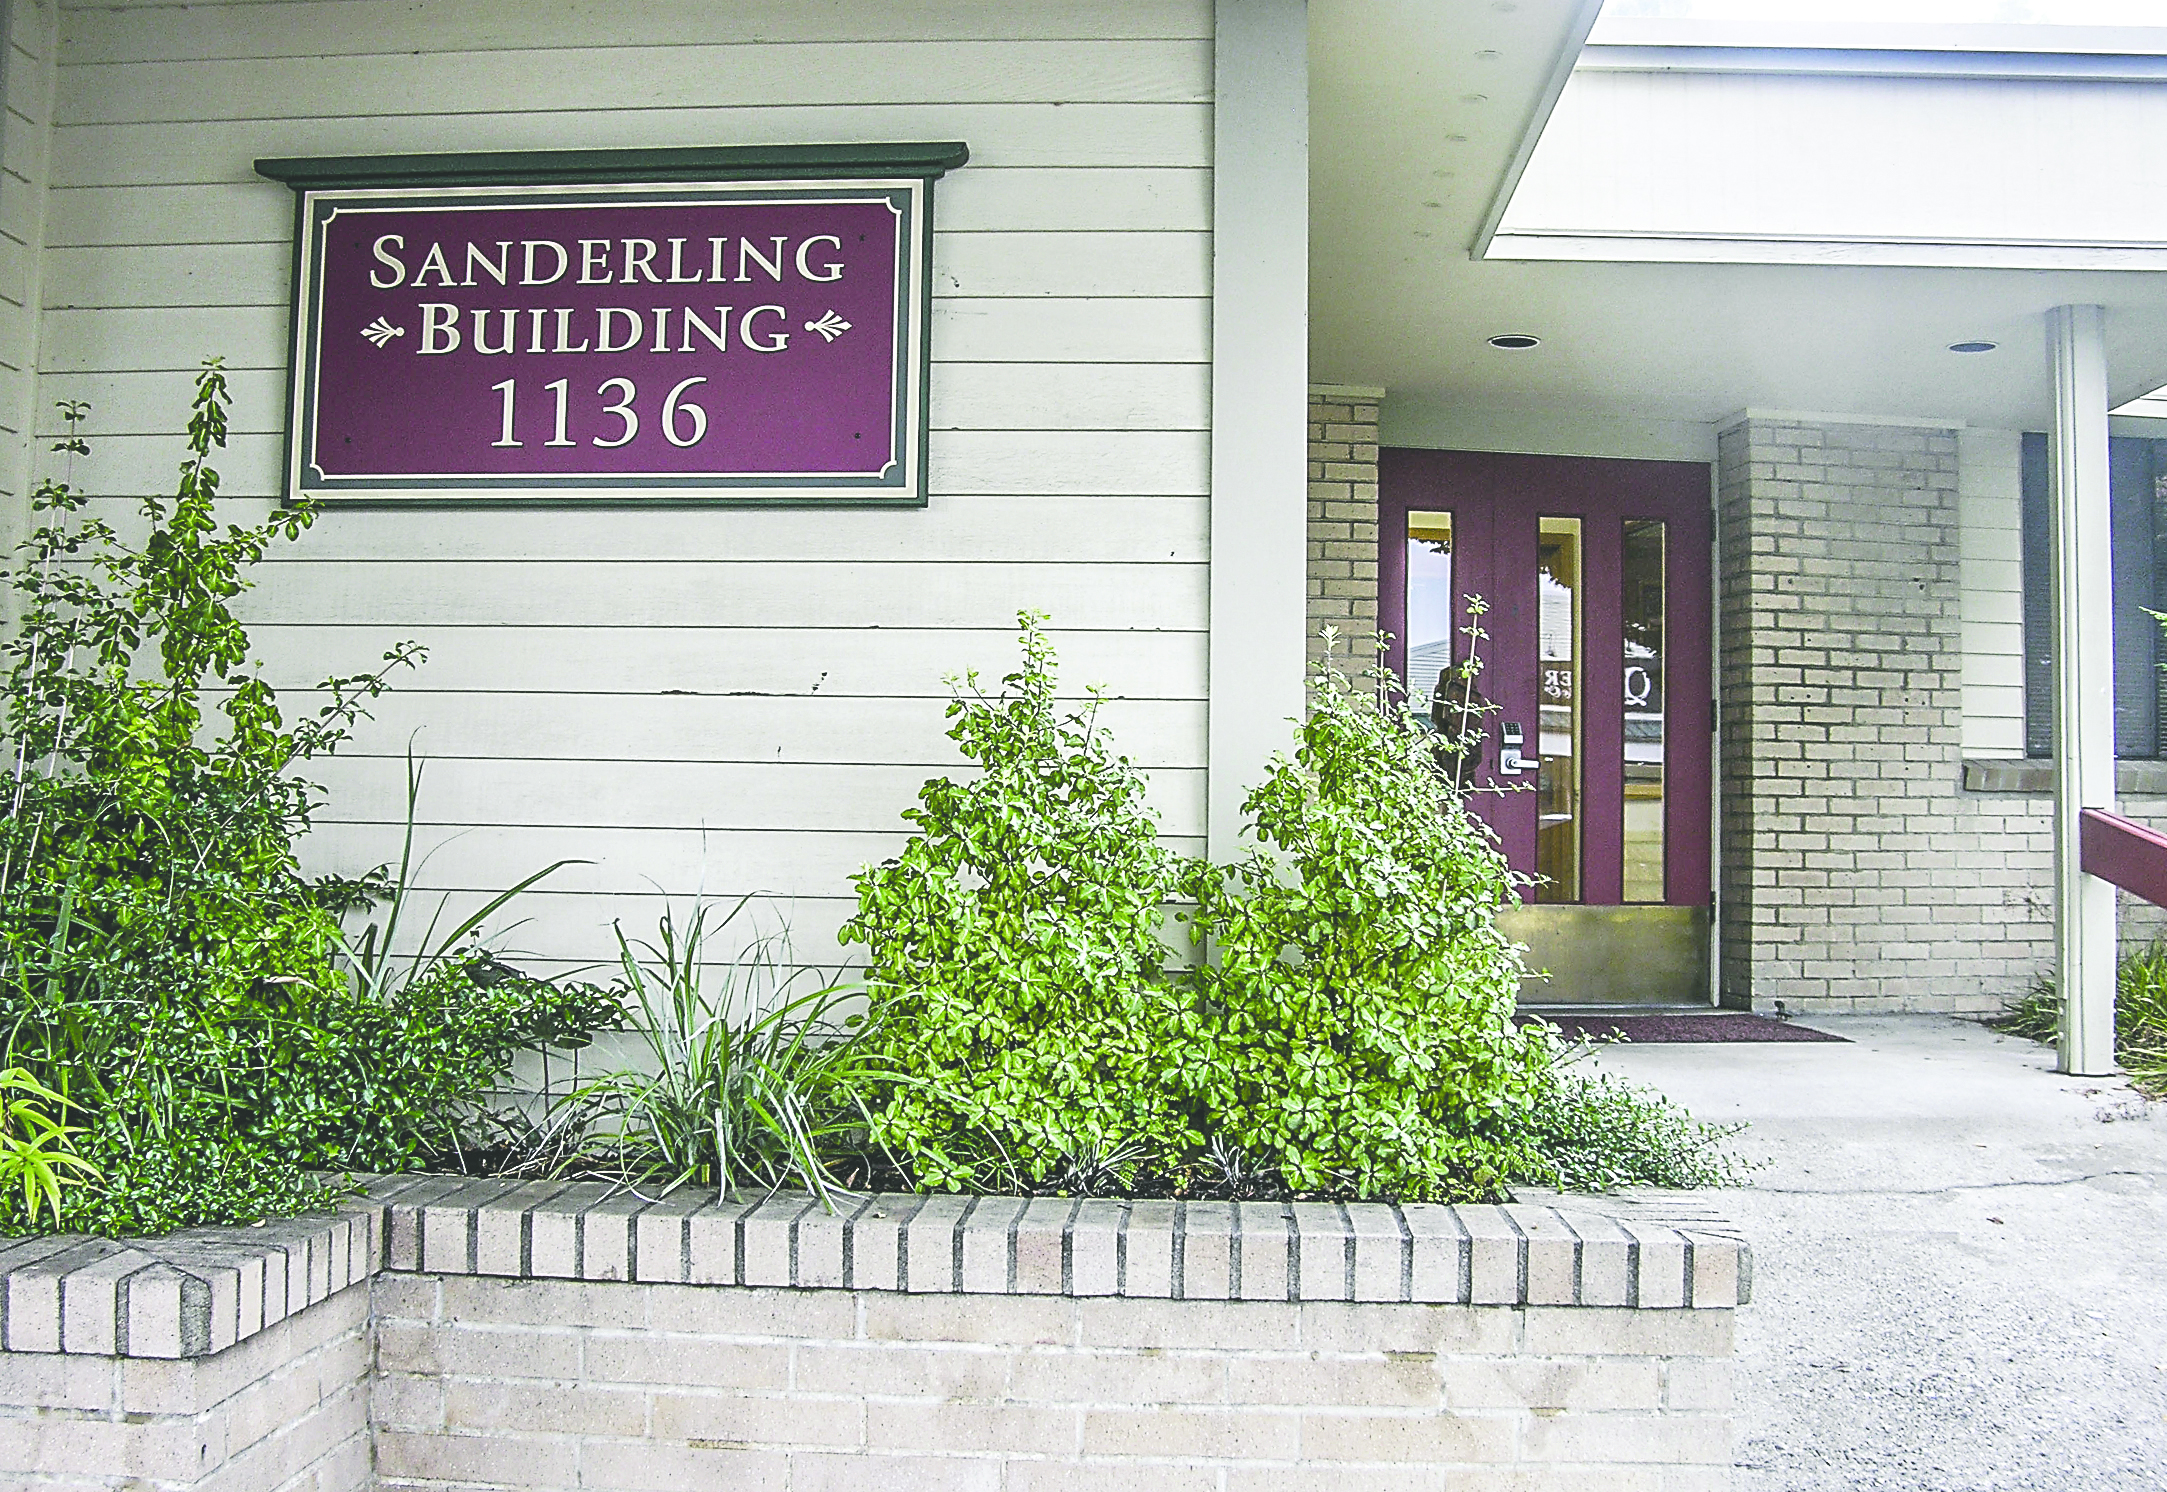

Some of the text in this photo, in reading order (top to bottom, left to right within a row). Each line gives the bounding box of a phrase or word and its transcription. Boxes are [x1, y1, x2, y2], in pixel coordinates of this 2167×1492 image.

[370, 233, 845, 288] SANDERLING
[416, 302, 790, 356] BUILDING
[491, 376, 708, 447] 1136
